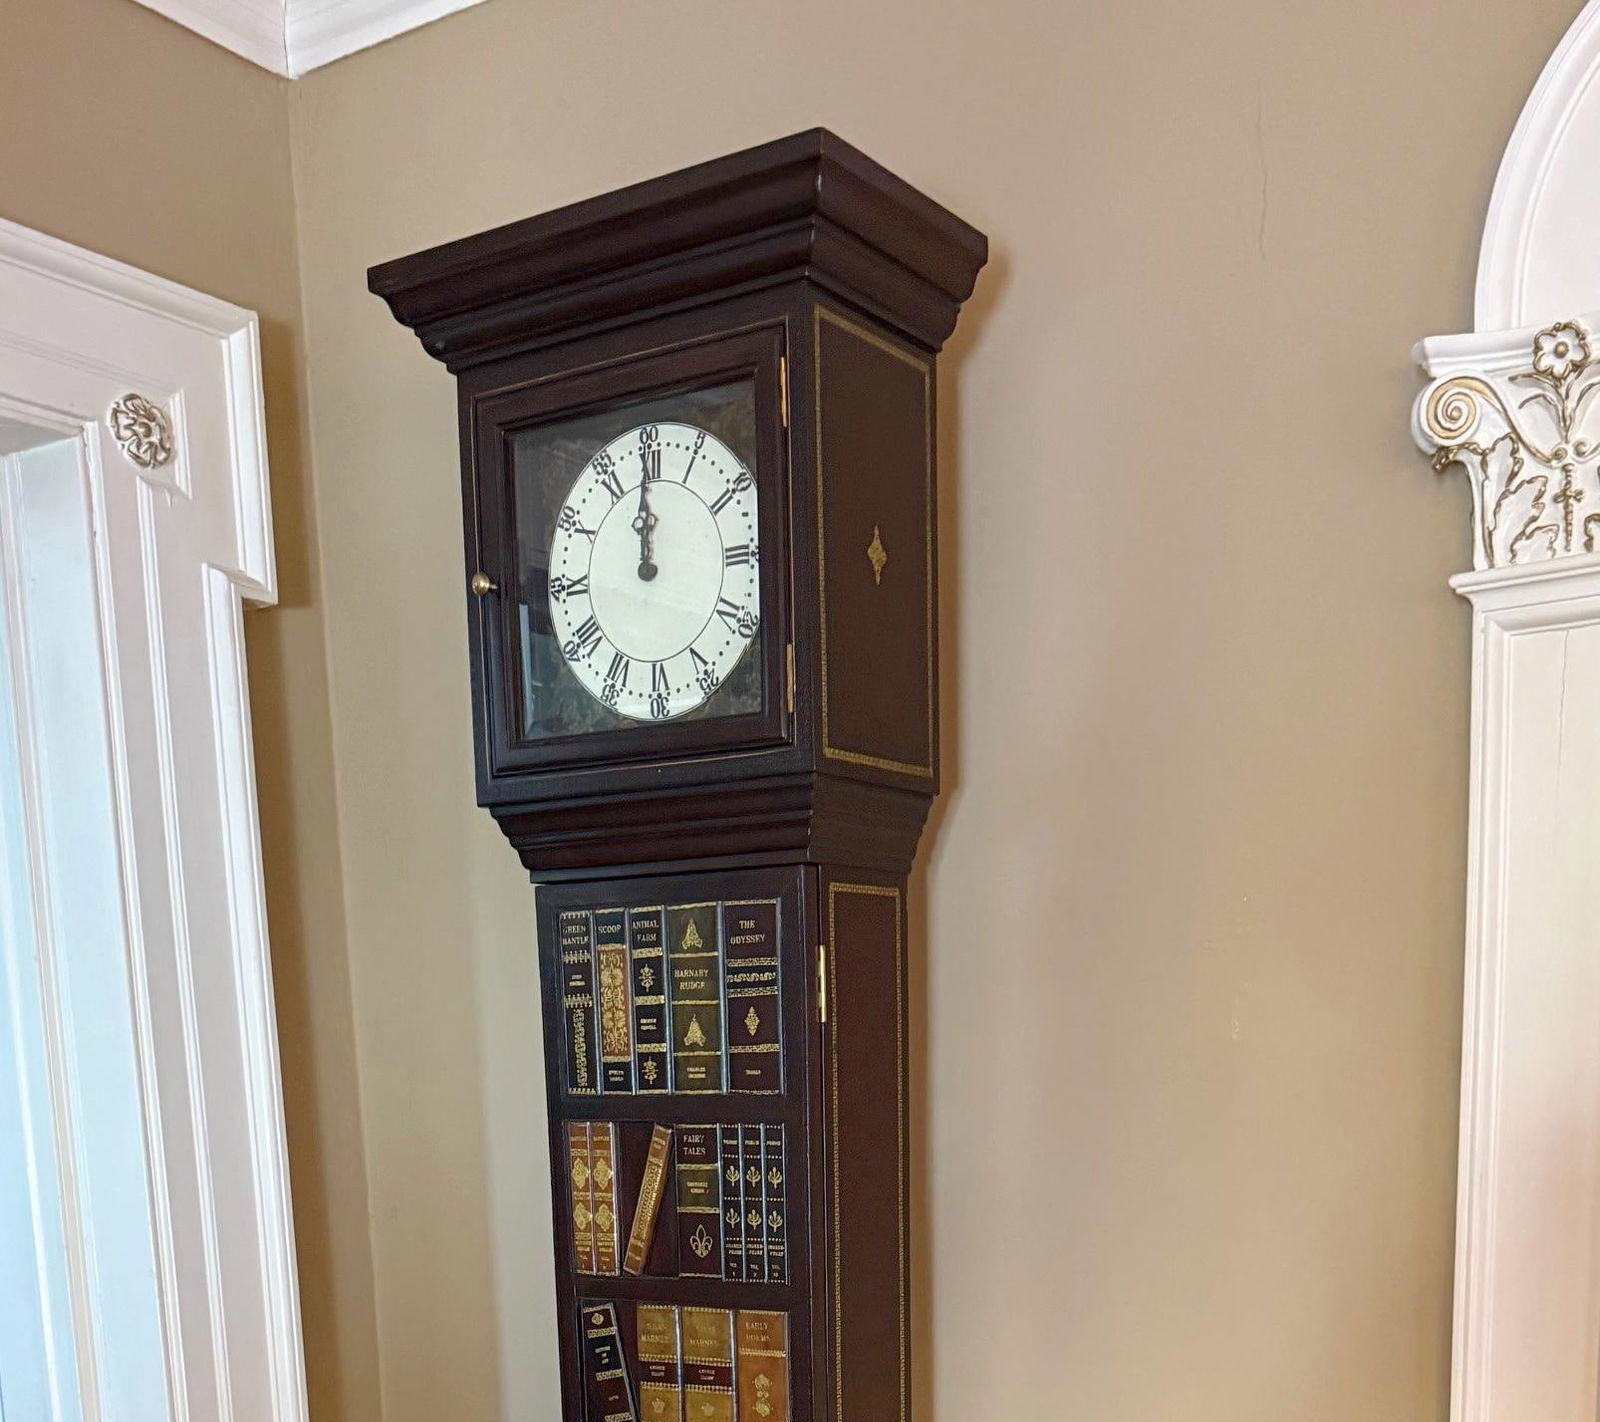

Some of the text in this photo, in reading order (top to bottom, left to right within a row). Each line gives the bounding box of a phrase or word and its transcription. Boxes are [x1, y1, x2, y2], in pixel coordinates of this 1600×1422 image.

[640, 425, 658, 444] 60
[694, 431, 706, 449] 5
[592, 449, 612, 475] 55
[639, 449, 661, 480] XII
[601, 469, 624, 505] XI
[733, 472, 752, 492] 10
[710, 488, 734, 516] II
[557, 506, 576, 532] 50
[574, 520, 596, 544] X
[725, 544, 750, 567] III
[550, 577, 562, 602] 45
[566, 574, 588, 597] IX
[716, 597, 740, 632] IV
[738, 611, 758, 639] 20
[576, 614, 603, 658] VIII
[563, 640, 580, 662] 40
[690, 647, 709, 675] V
[606, 652, 630, 688] VII
[652, 663, 670, 692] VI
[700, 668, 719, 695] 25
[601, 684, 620, 706] 35
[650, 697, 670, 718] 30
[598, 925, 621, 933] SCOOP
[632, 920, 659, 929] ANIMAL
[739, 920, 755, 929] THE
[730, 935, 765, 944] ODYSSEY
[680, 982, 705, 990] RUDGE
